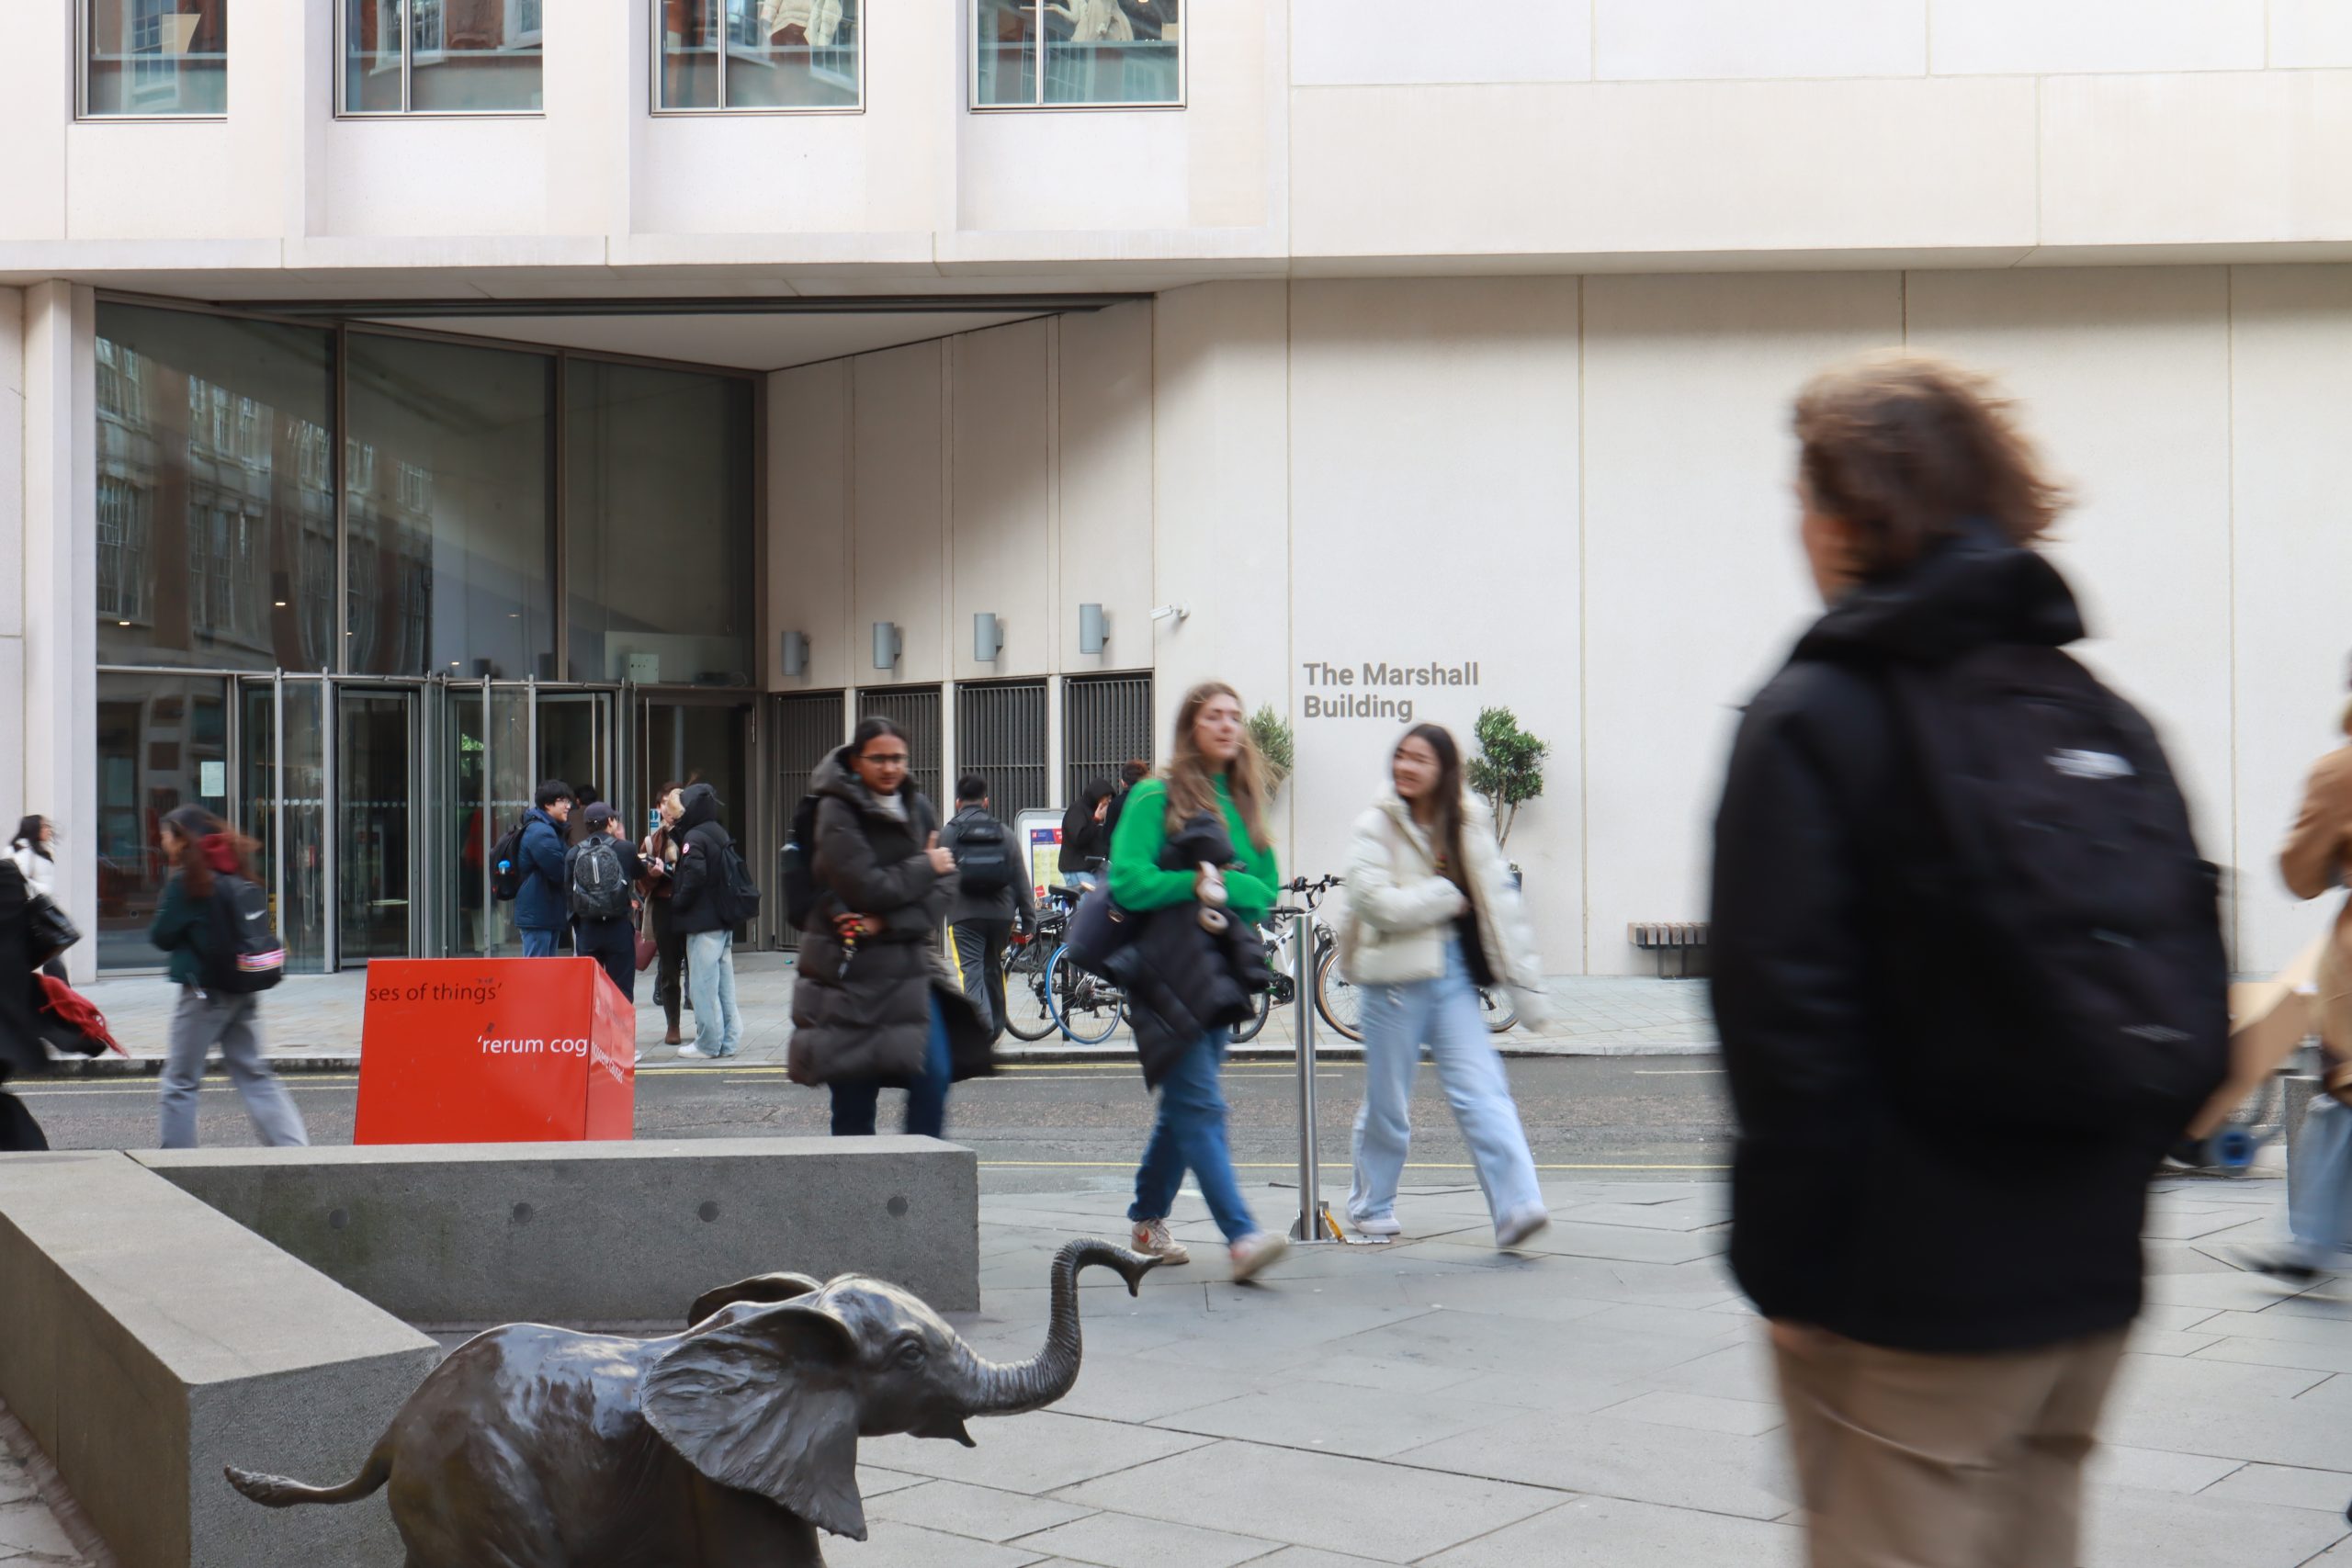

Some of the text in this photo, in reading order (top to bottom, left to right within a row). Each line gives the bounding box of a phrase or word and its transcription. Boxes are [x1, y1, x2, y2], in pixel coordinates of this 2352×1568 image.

[1303, 661, 1478, 685] The Marshall
[1304, 694, 1413, 724] Building
[369, 982, 503, 1005] ses of things'
[550, 1038, 588, 1057] cog
